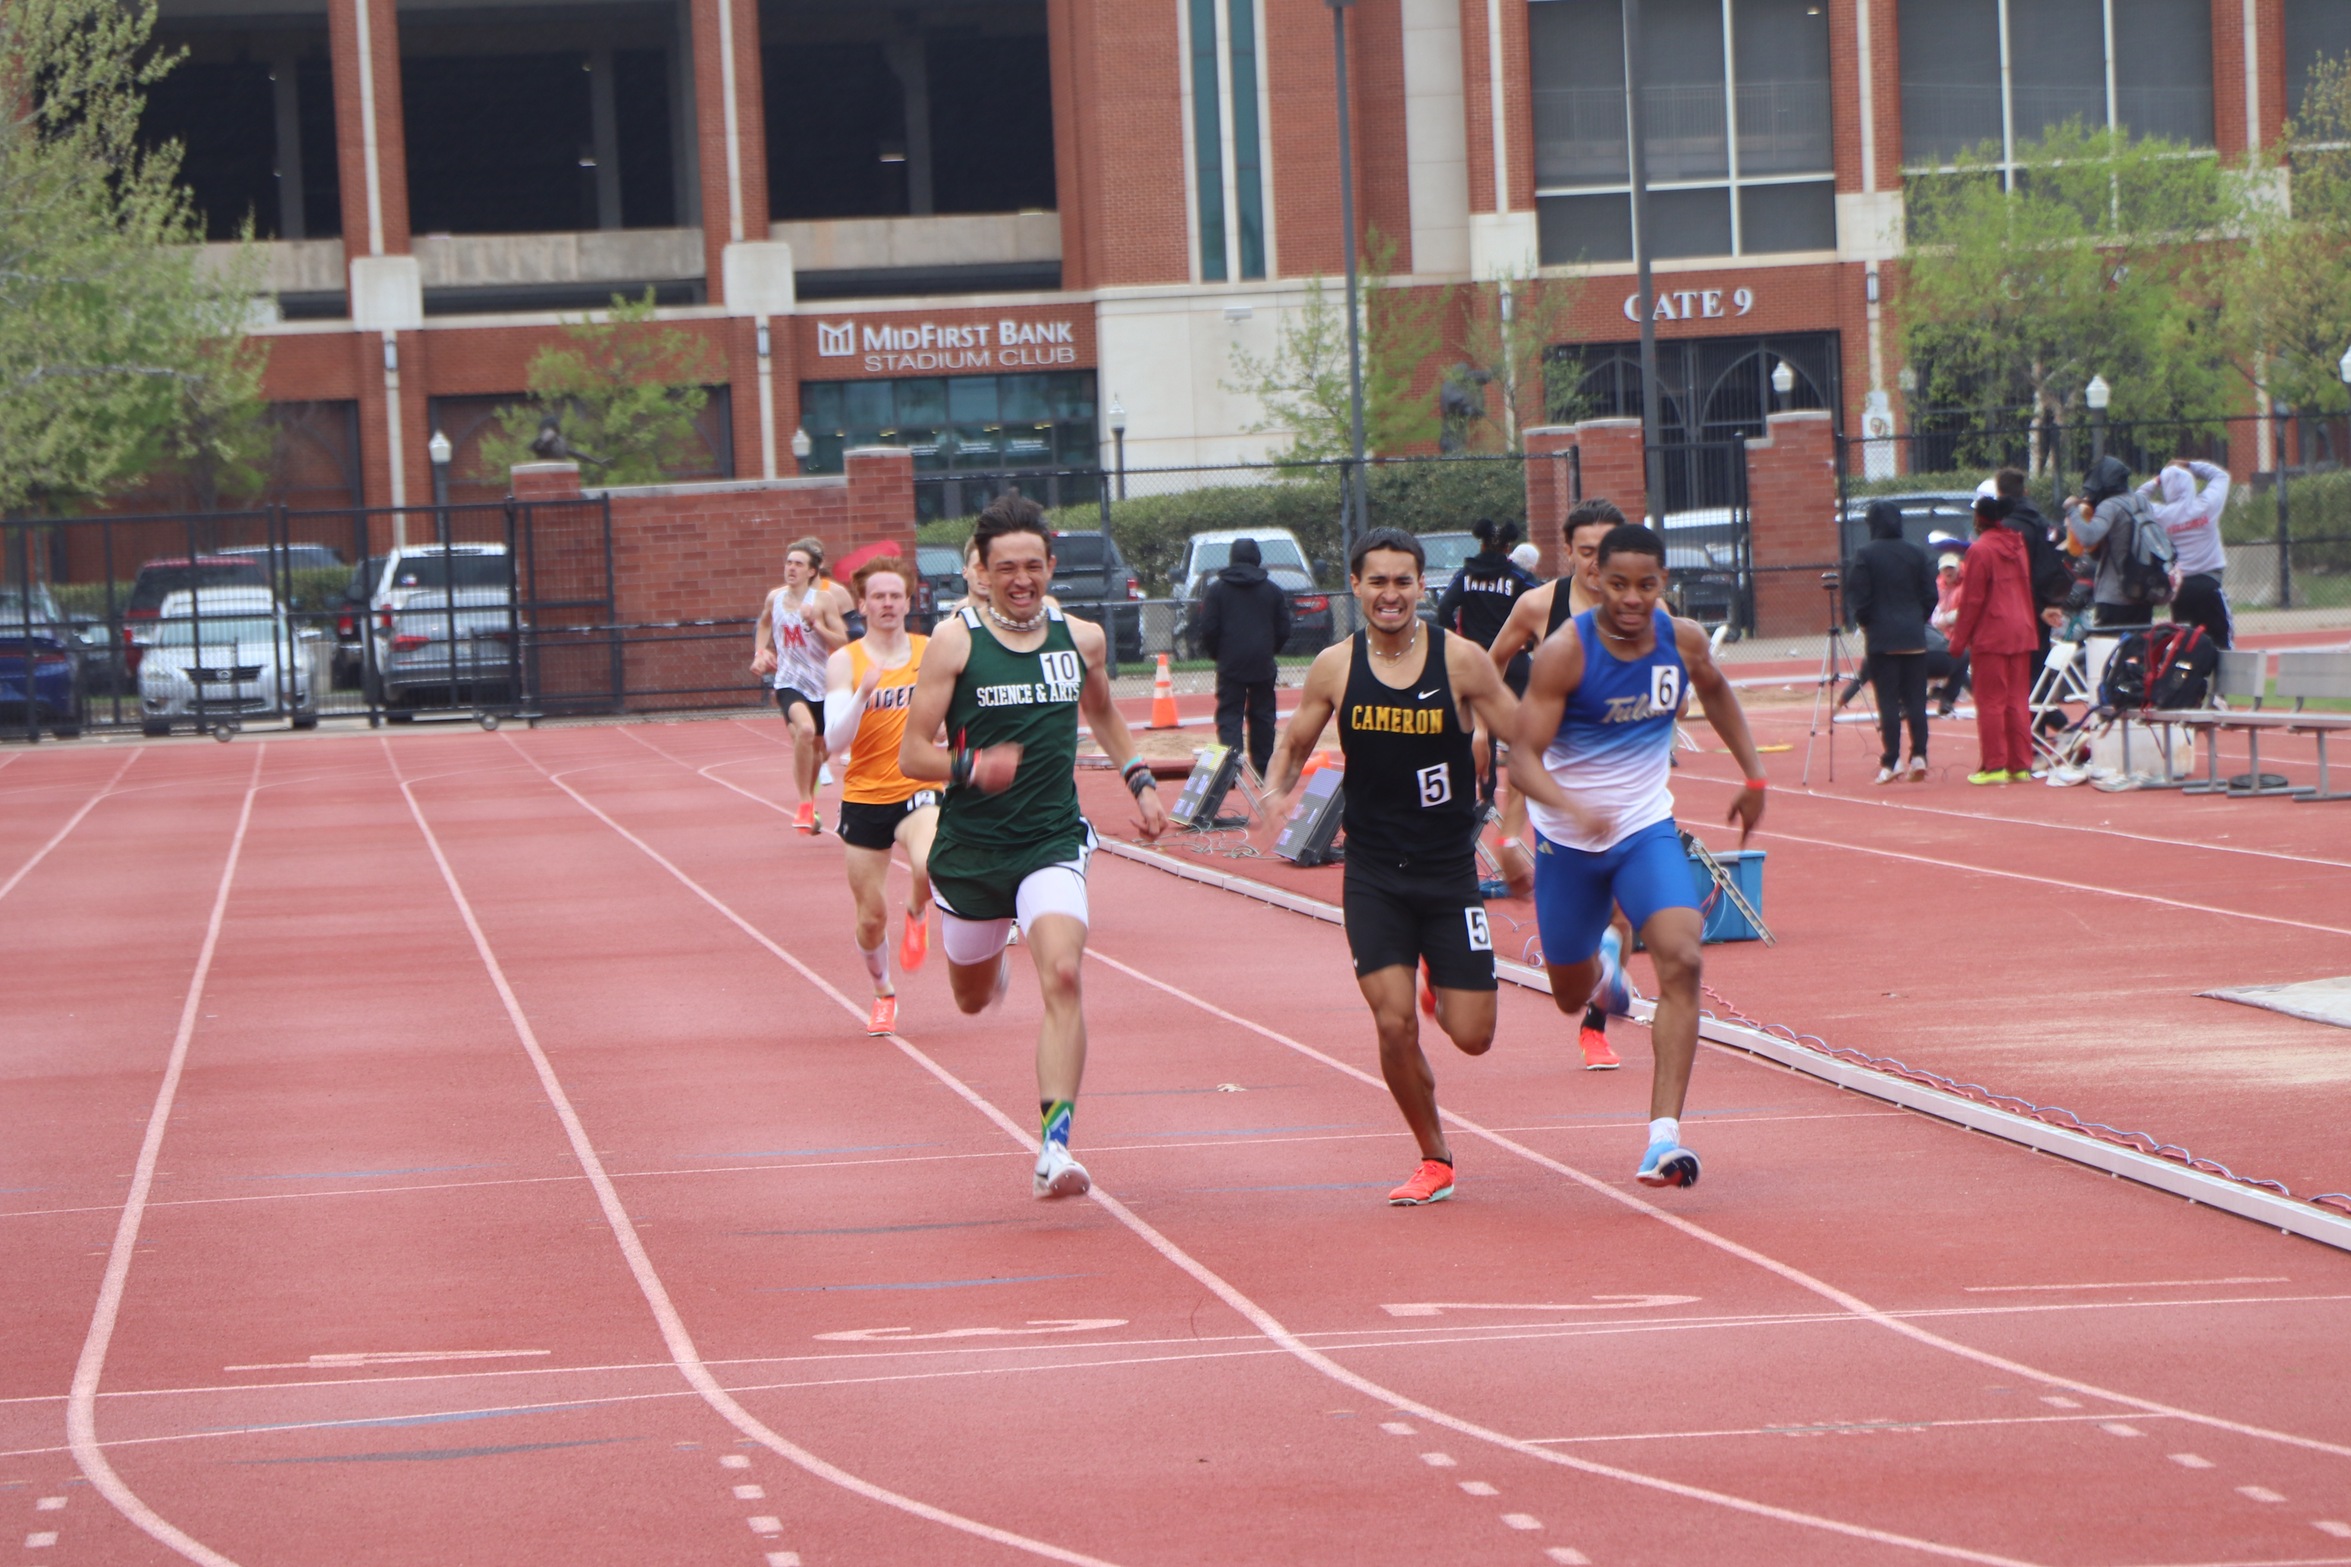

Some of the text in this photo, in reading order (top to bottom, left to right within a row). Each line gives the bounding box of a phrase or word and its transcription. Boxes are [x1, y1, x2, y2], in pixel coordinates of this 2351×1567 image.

[1733, 288, 1753, 317] 9
[864, 347, 1075, 372] STADIUM CLUB
[782, 623, 807, 649] M
[1045, 653, 1075, 682] 10
[976, 681, 1080, 707] SCIENCE & ARTS
[1658, 669, 1672, 706] 6
[1352, 705, 1443, 734] CAMERON
[1425, 767, 1445, 803] 5
[1471, 911, 1489, 945] 5
